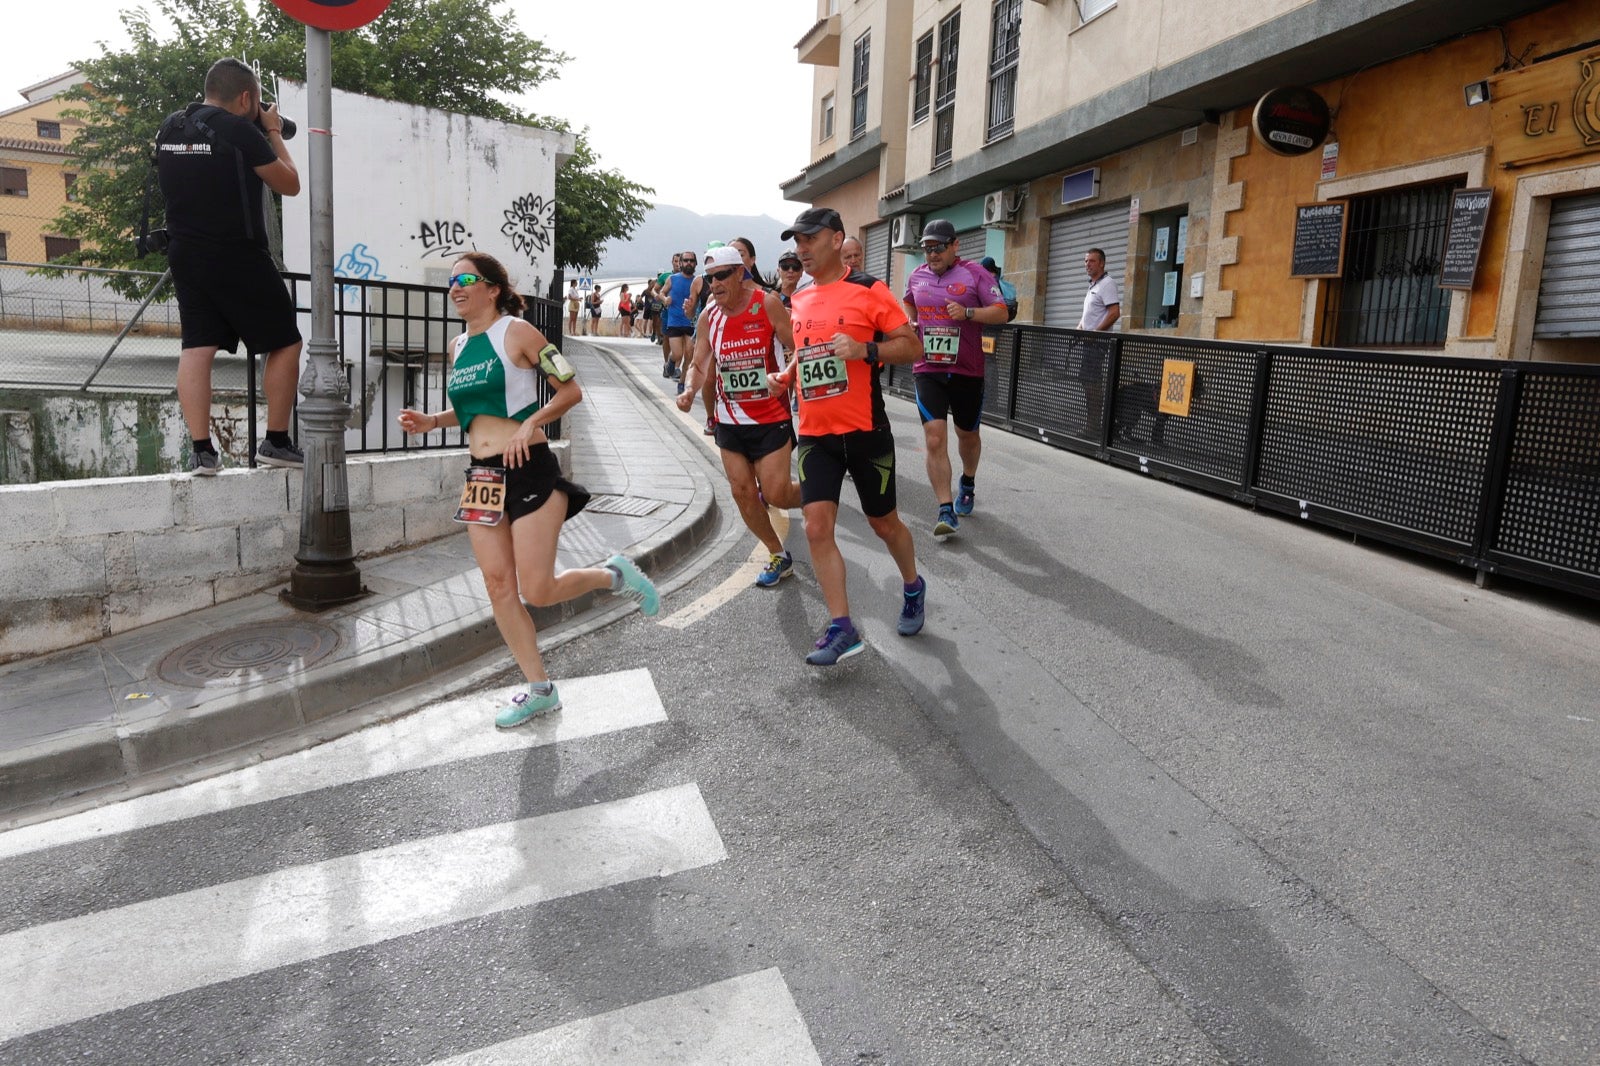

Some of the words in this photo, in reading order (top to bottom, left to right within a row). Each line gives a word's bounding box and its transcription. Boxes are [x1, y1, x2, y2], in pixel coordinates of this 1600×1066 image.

[1525, 104, 1559, 136] El
[929, 337, 951, 351] 171
[719, 346, 766, 362] Polisalud
[451, 362, 486, 376] DEPORTES
[803, 360, 838, 383] 546
[730, 371, 761, 389] 602
